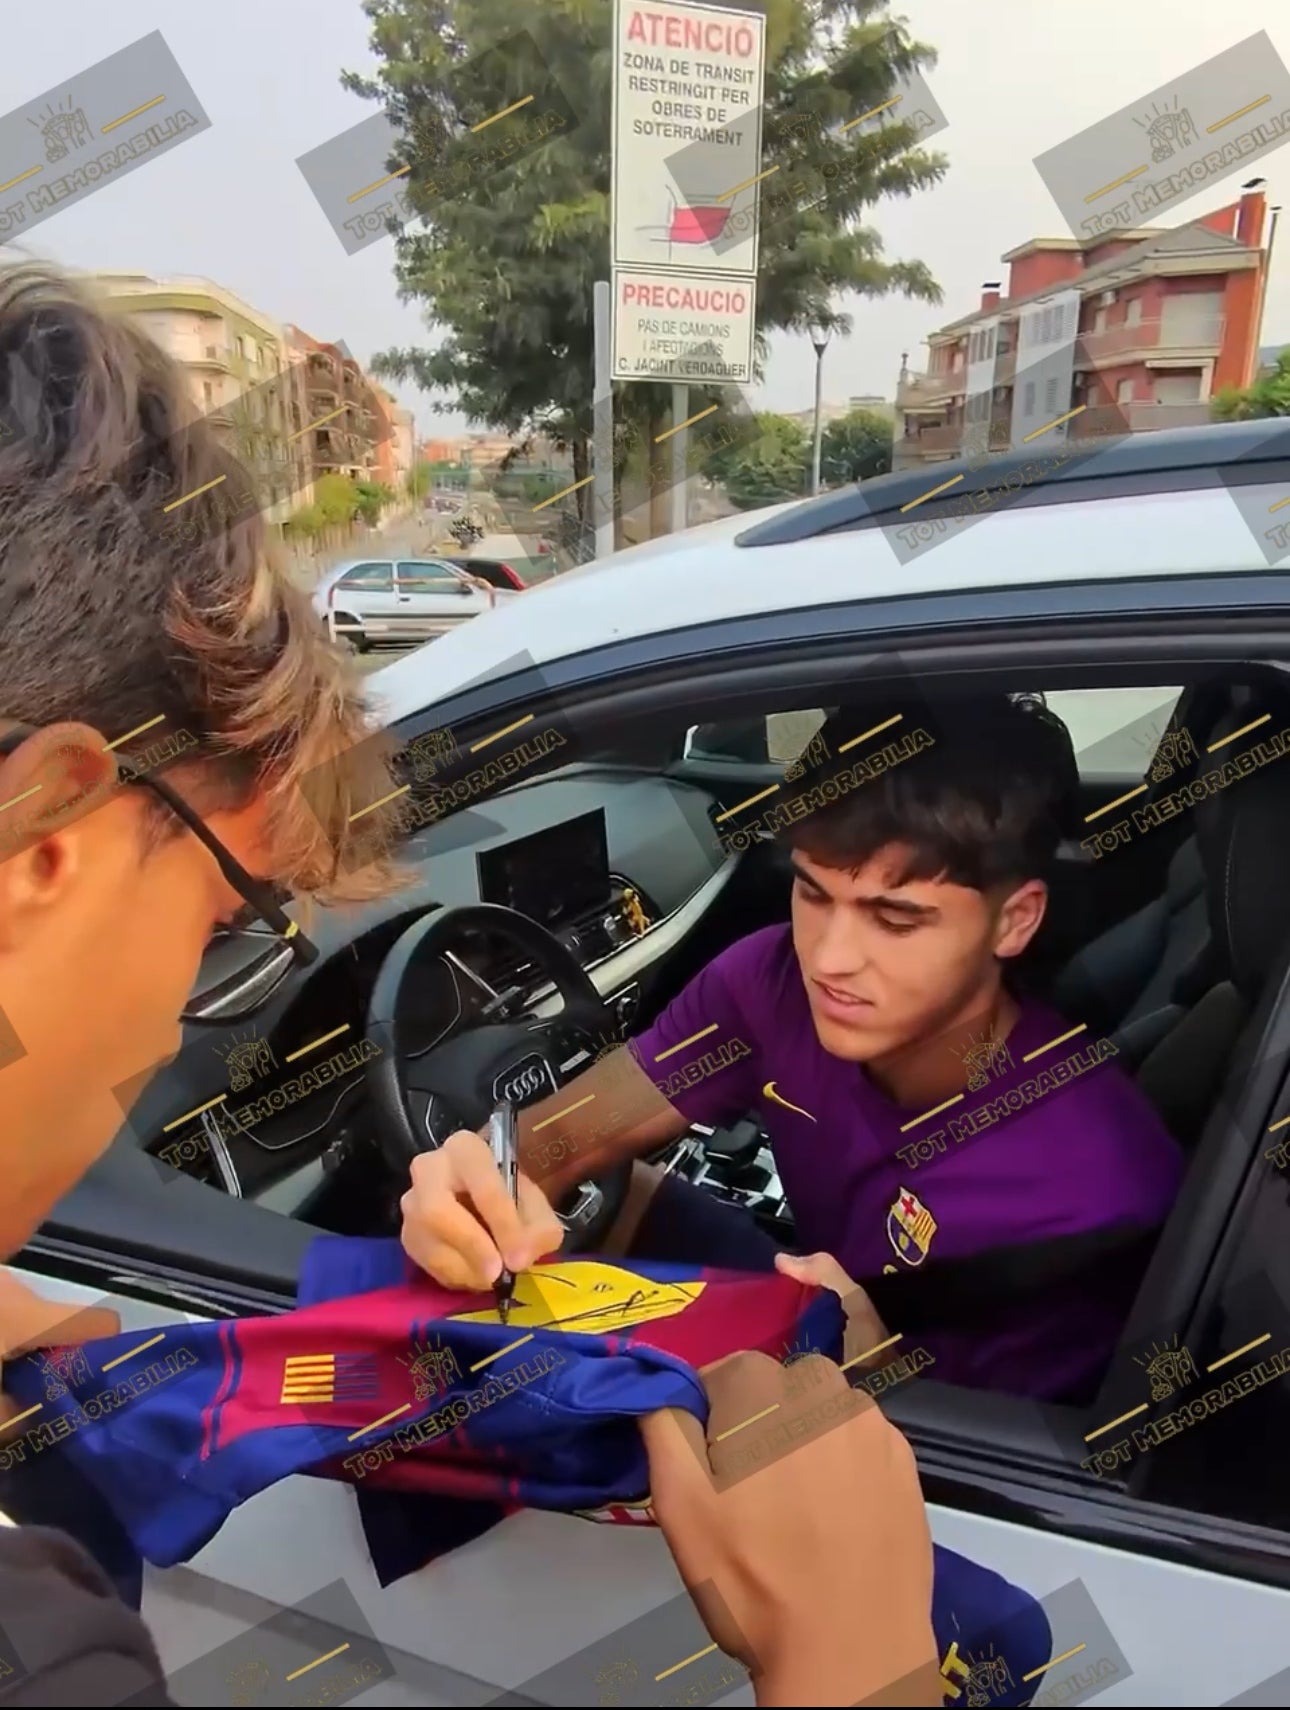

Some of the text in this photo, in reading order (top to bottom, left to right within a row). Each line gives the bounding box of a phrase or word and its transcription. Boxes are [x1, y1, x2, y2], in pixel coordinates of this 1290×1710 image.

[628, 11, 752, 57] ATENCIÓ
[624, 52, 755, 84] ZONA DE TRANSIT
[629, 75, 749, 105] RESTRINGIT PER
[651, 100, 726, 123] OBRES DE
[633, 119, 743, 146] SOTERRAMENT
[623, 283, 745, 314] PRECAUCIÓ
[638, 318, 731, 338] PAS DE CAMIONS
[634, 358, 673, 374] JACINT
